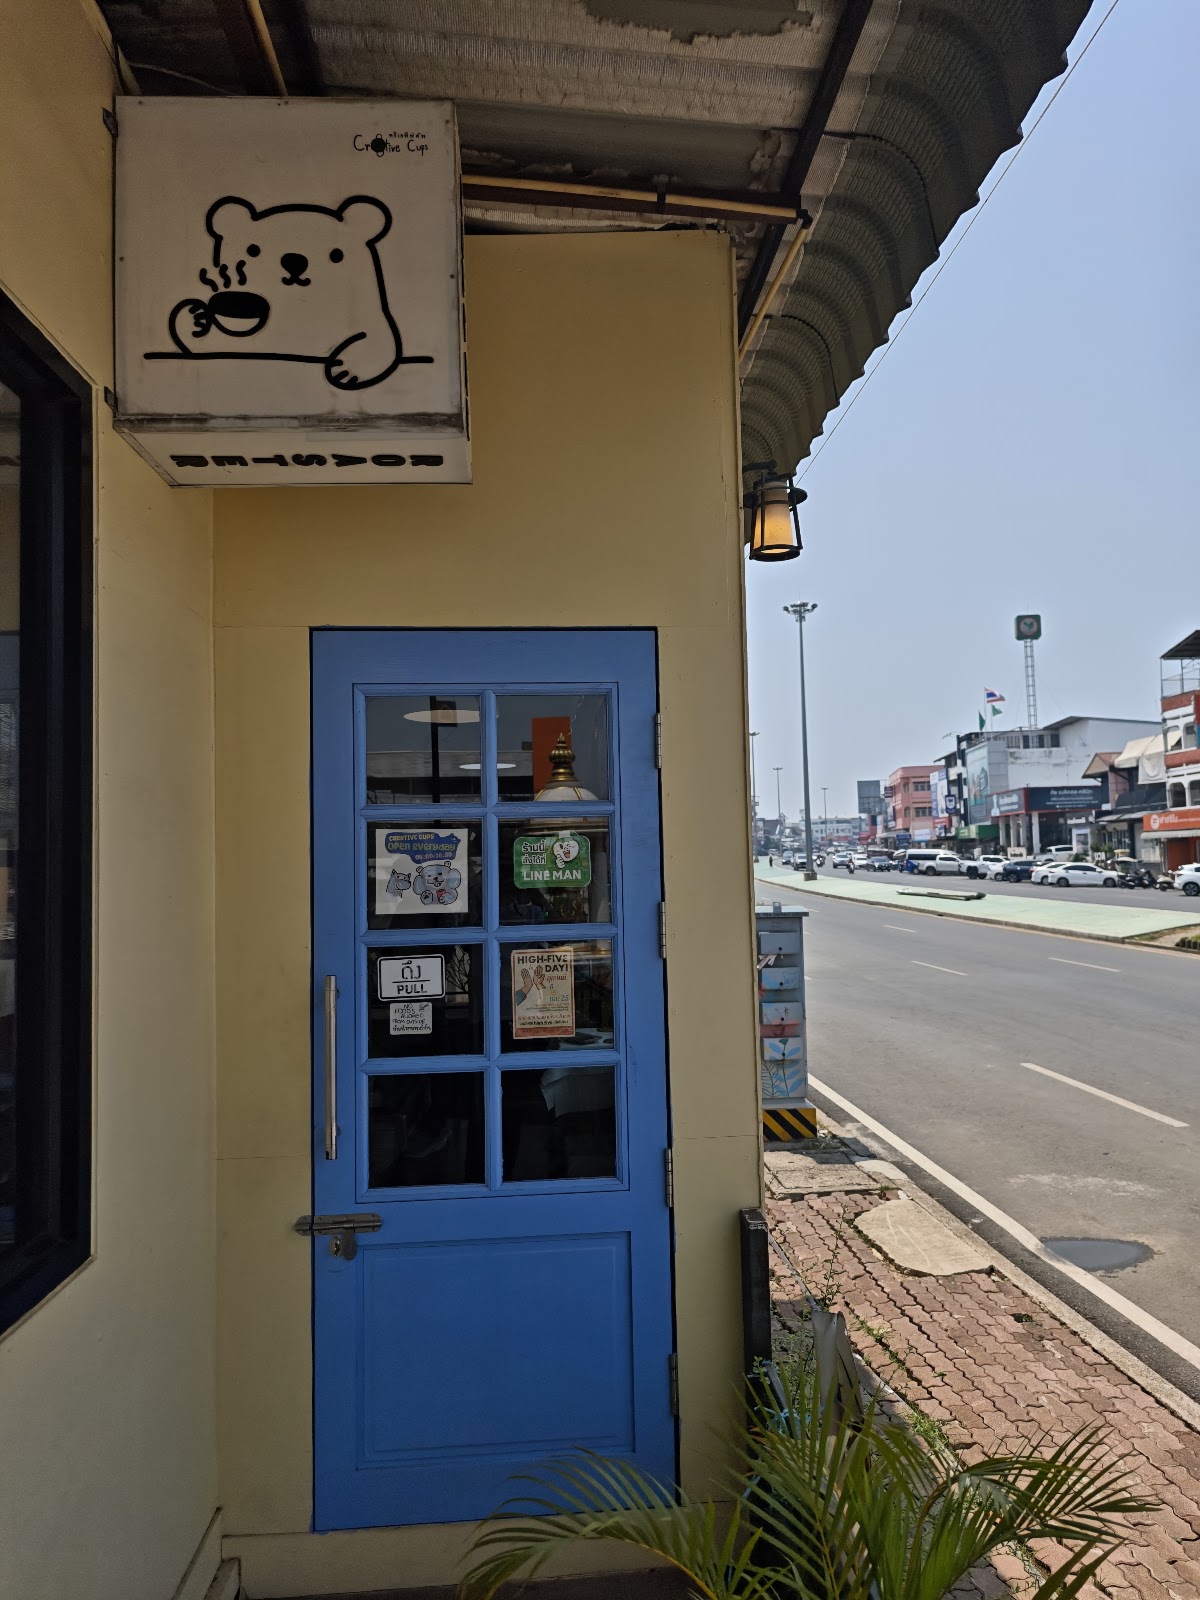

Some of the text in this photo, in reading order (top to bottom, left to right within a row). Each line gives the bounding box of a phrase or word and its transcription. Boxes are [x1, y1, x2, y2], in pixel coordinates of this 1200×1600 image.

[407, 139, 429, 156] Cups
[170, 454, 444, 467] ROASTER
[412, 842, 456, 852] everyday
[522, 839, 546, 853] ร้านนี้
[522, 853, 547, 864] สั่งได้ที่
[522, 869, 582, 881] LINE MAN
[517, 955, 568, 964] HIGH-FIVE
[401, 960, 421, 979] ดึง
[545, 964, 569, 973] DAY!
[397, 984, 427, 994] PULL
